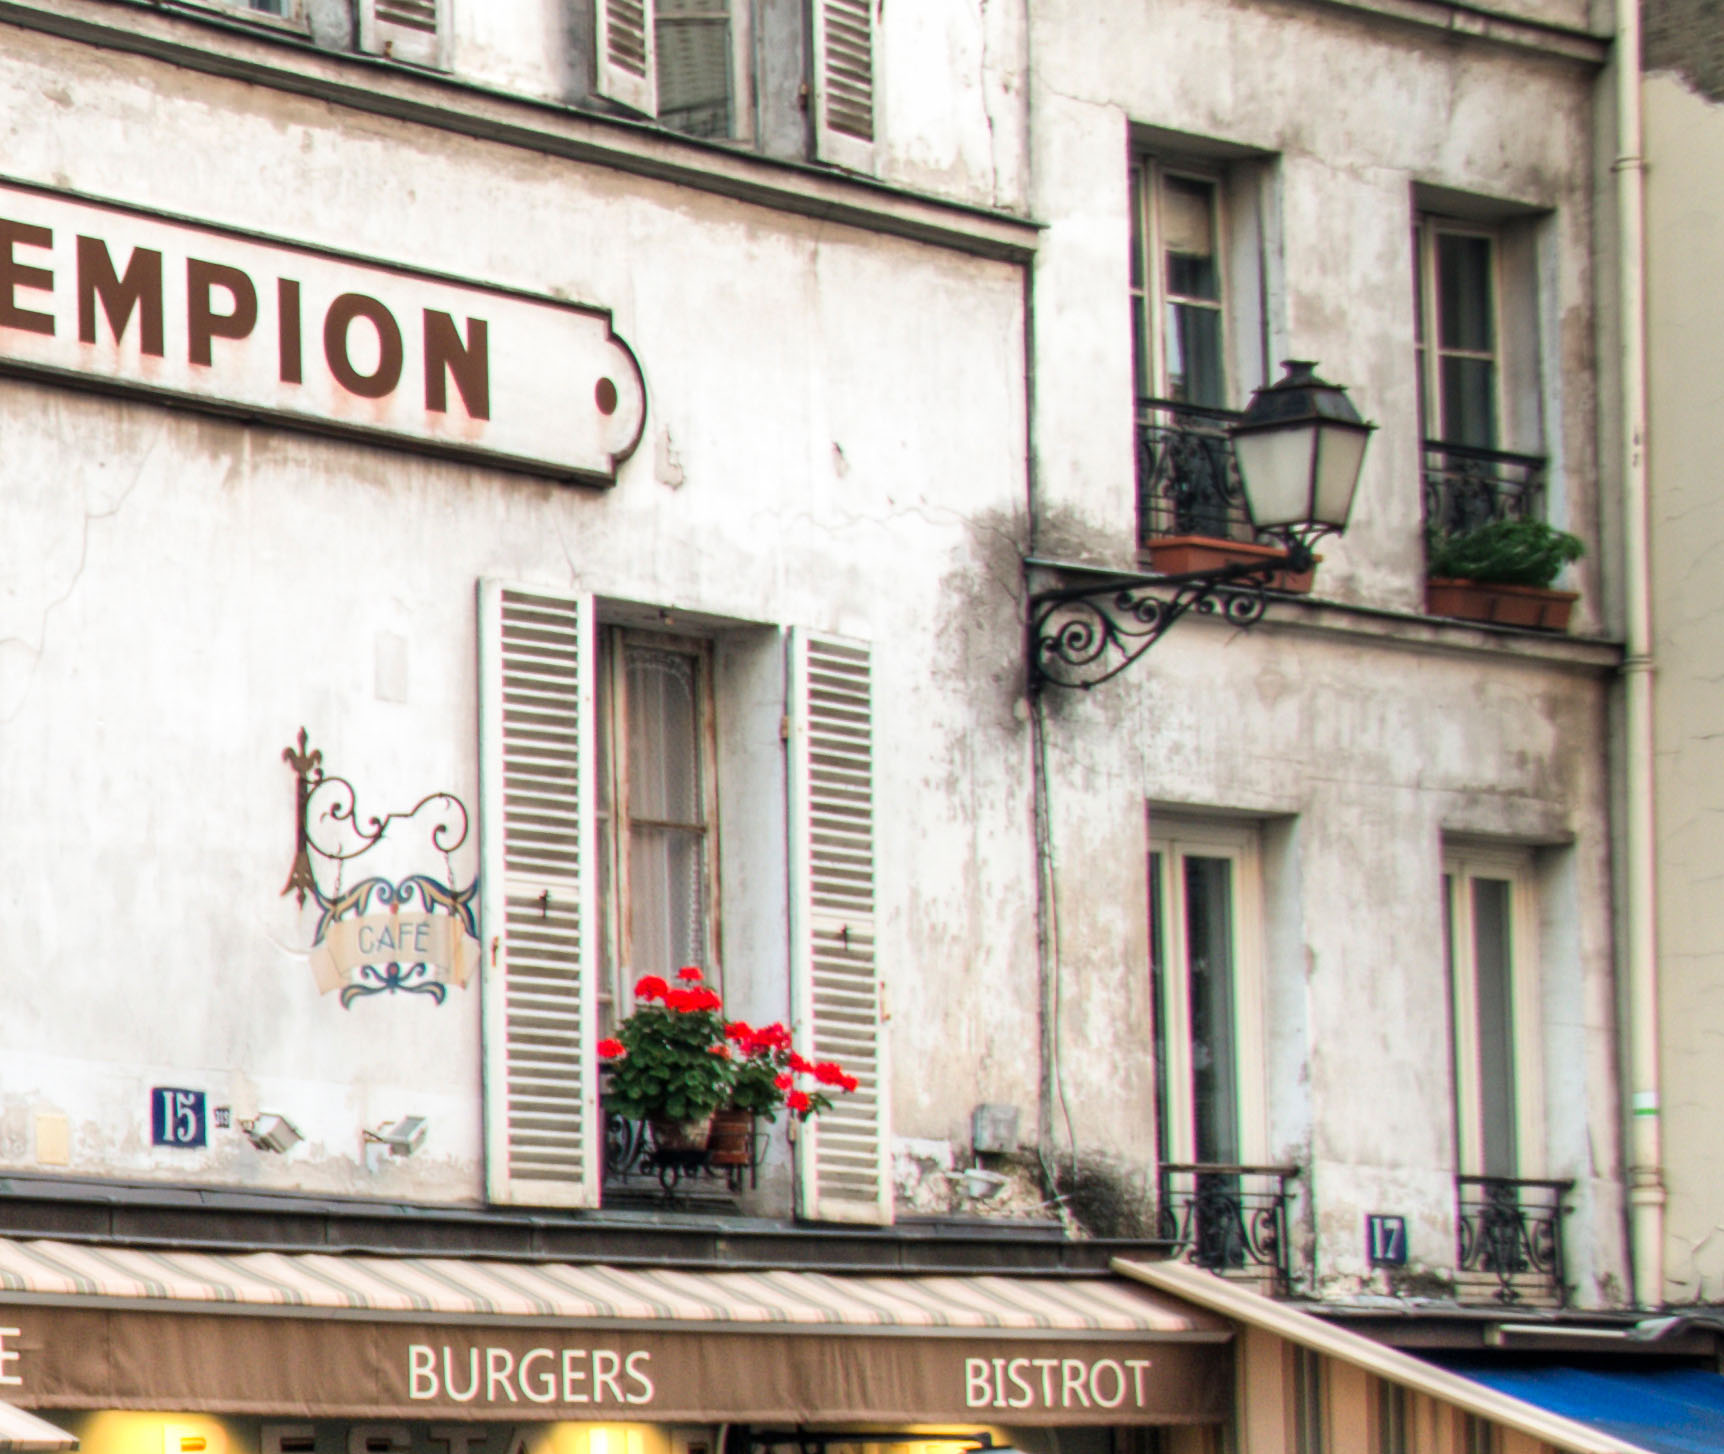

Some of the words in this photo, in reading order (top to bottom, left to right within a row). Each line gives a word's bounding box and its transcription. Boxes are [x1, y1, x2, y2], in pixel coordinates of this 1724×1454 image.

[162, 1090, 197, 1142] 15
[1372, 1218, 1402, 1259] 17
[408, 1344, 655, 1405] BURGERS
[965, 1357, 1151, 1409] BISTROT
